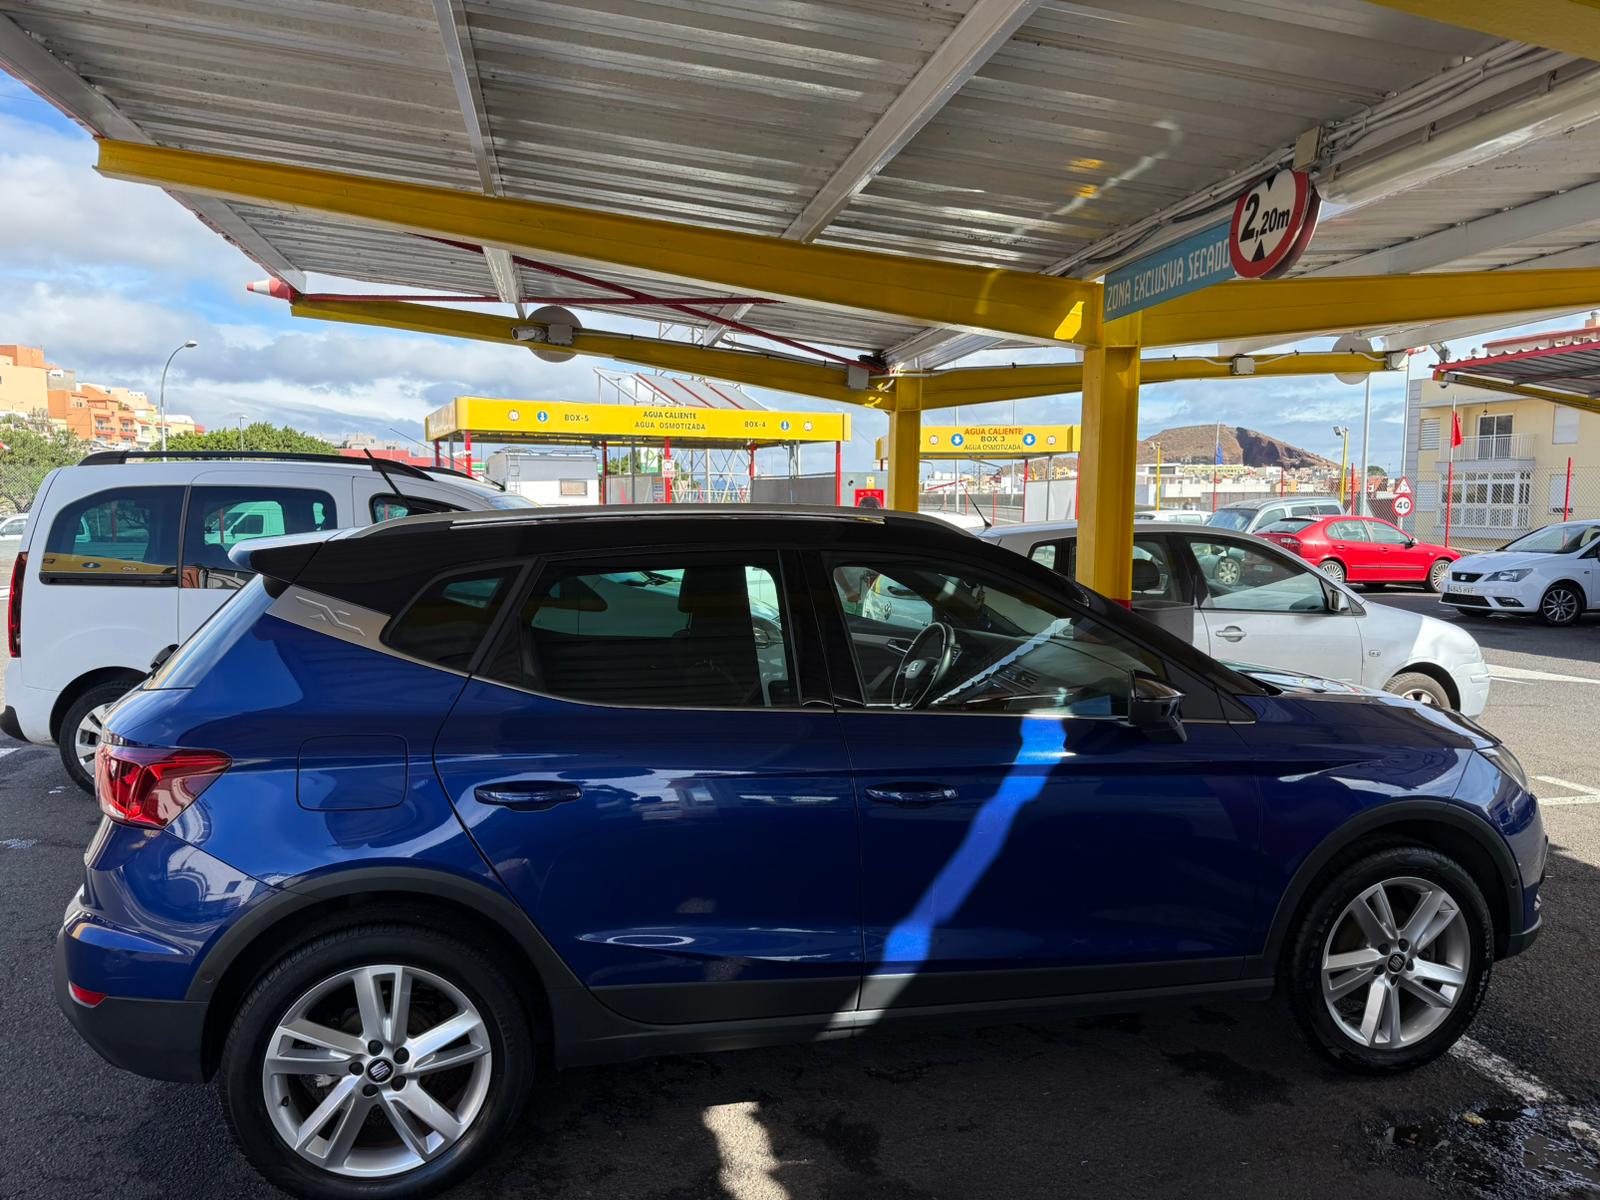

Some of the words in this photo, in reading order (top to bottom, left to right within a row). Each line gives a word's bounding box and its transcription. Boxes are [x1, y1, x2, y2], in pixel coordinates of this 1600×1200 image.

[1239, 192, 1291, 243] 2,20m
[1106, 279, 1131, 312] ZONA
[1133, 256, 1185, 302] EXCLUSIVA
[564, 414, 589, 422] BOX-5
[643, 411, 663, 419] AGUA
[664, 411, 697, 420] CALIENTE
[635, 421, 655, 429] AGUA
[659, 422, 706, 430] OSMOTIZADA
[980, 435, 998, 443] BOX
[1396, 501, 1410, 510] 40
